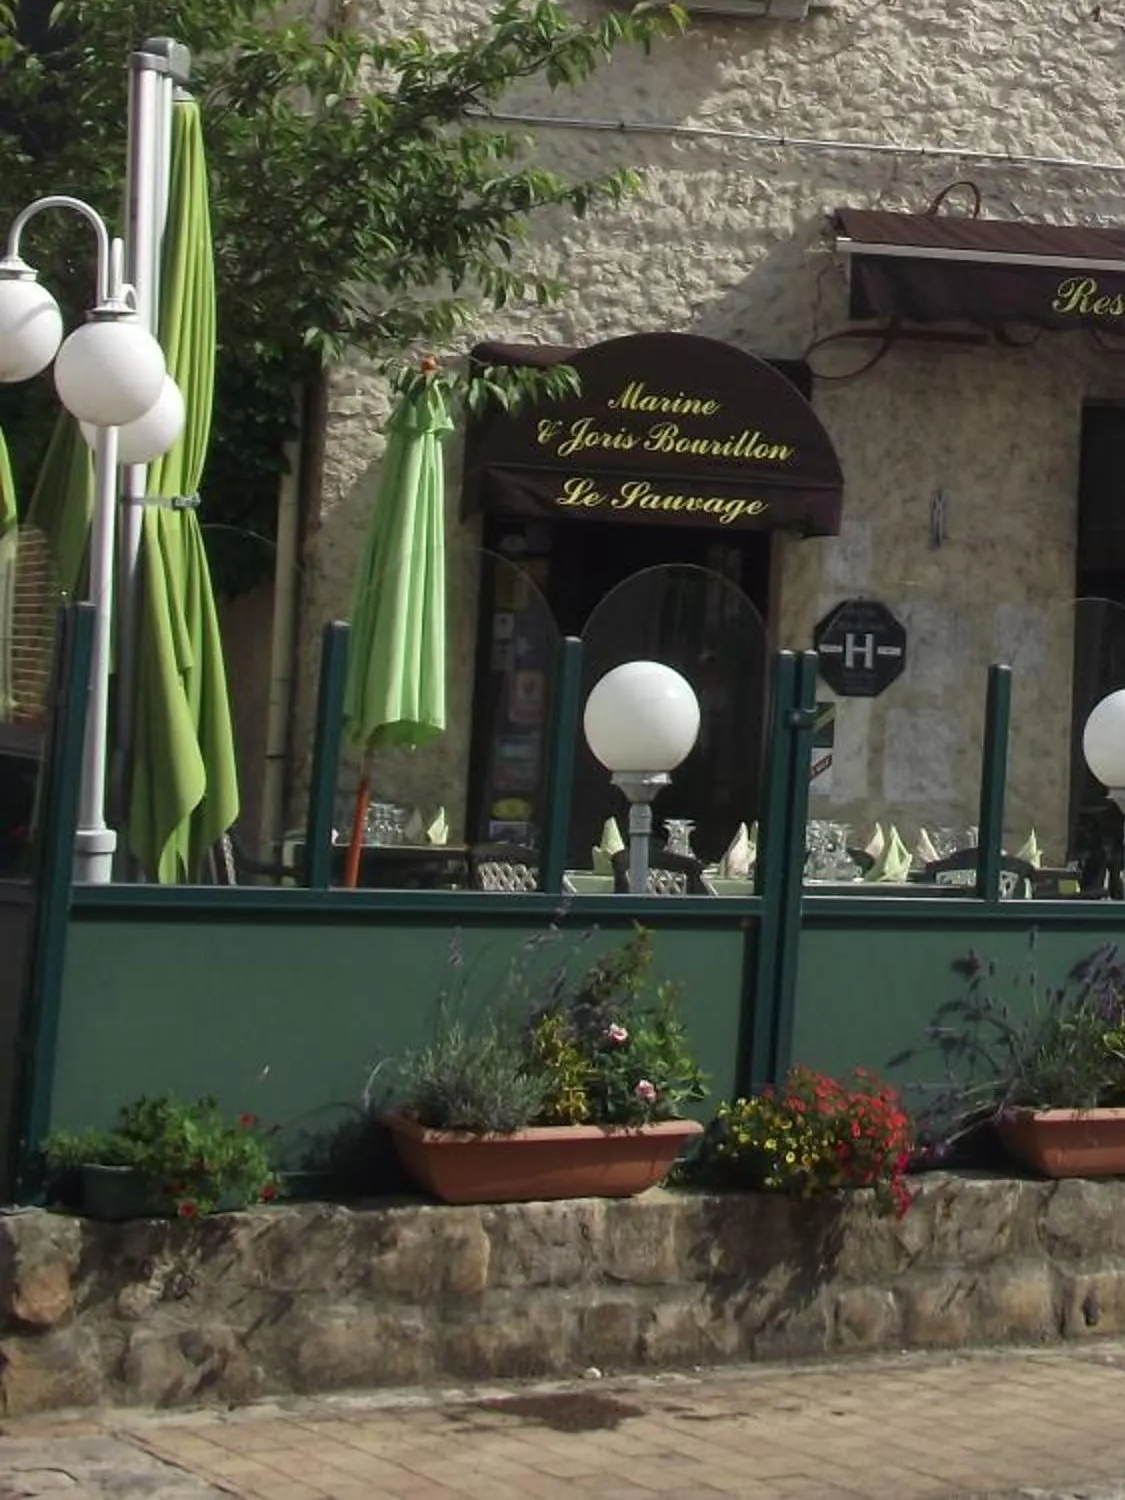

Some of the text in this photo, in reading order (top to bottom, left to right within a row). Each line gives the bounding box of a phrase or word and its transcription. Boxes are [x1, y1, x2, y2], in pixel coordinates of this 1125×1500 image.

[607, 380, 720, 416] Marine
[557, 416, 641, 457] Joris
[643, 421, 795, 461] Bourillon
[556, 476, 769, 524] Le Sauvage
